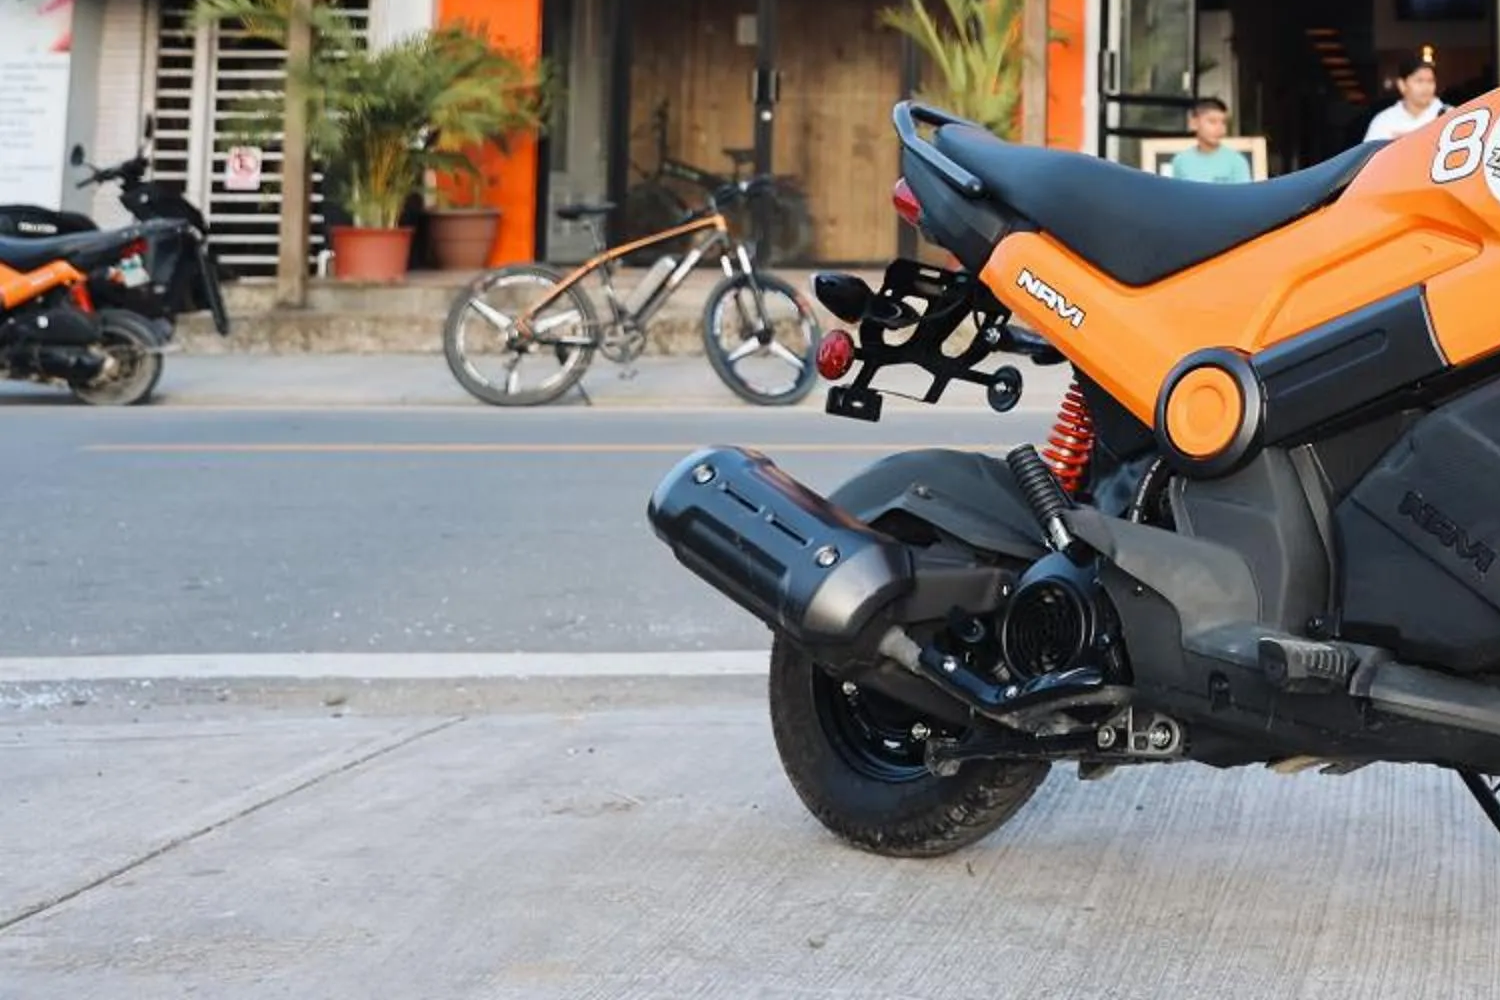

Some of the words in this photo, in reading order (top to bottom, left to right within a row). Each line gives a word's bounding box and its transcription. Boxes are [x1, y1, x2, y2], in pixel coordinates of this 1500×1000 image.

[1430, 107, 1492, 184] 8
[1017, 268, 1086, 328] NAVI
[1399, 491, 1496, 573] NAVI
